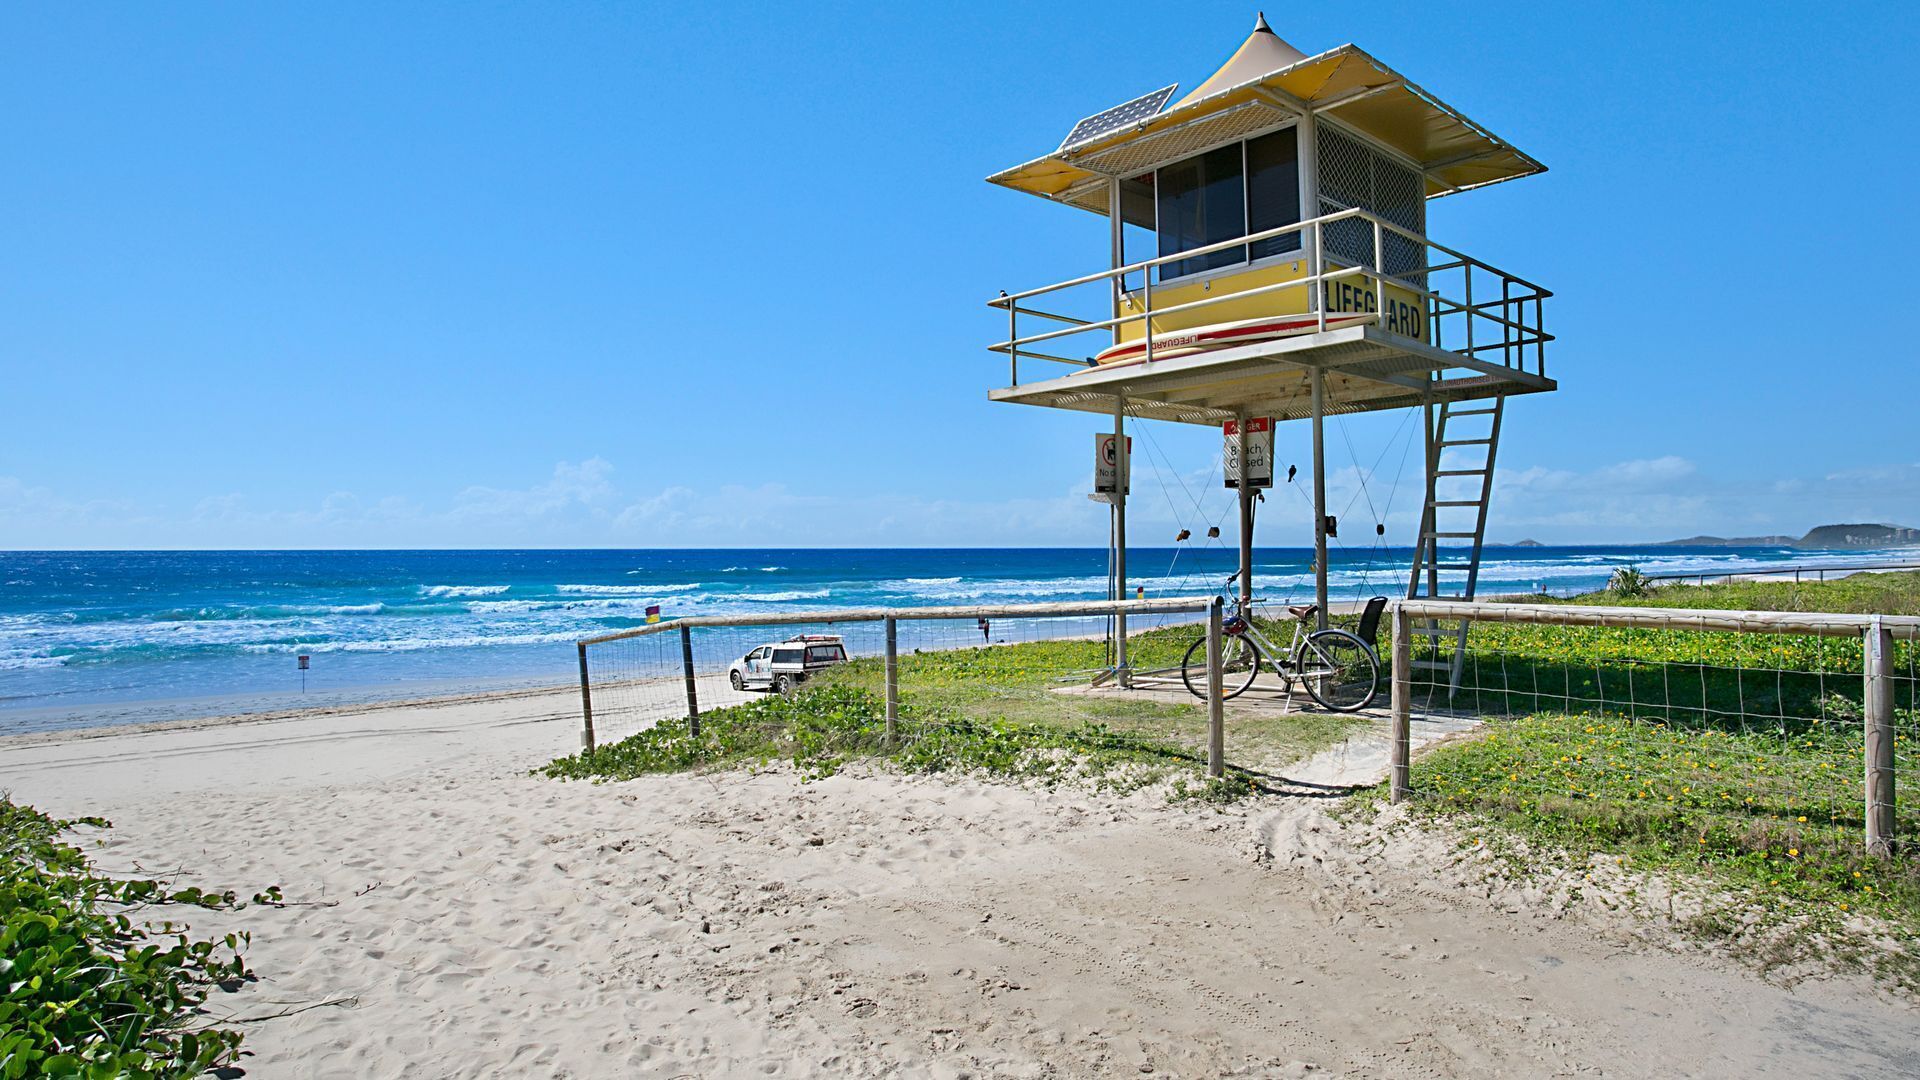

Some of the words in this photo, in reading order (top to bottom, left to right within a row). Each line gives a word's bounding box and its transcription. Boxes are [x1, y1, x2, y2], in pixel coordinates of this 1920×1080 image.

[1325, 281, 1420, 338] LIFEGARD
[1152, 334, 1197, 350] LIFEGUARD
[1231, 443, 1262, 456] Bach
[1229, 456, 1264, 469] Clsed
[1099, 468, 1109, 477] No
